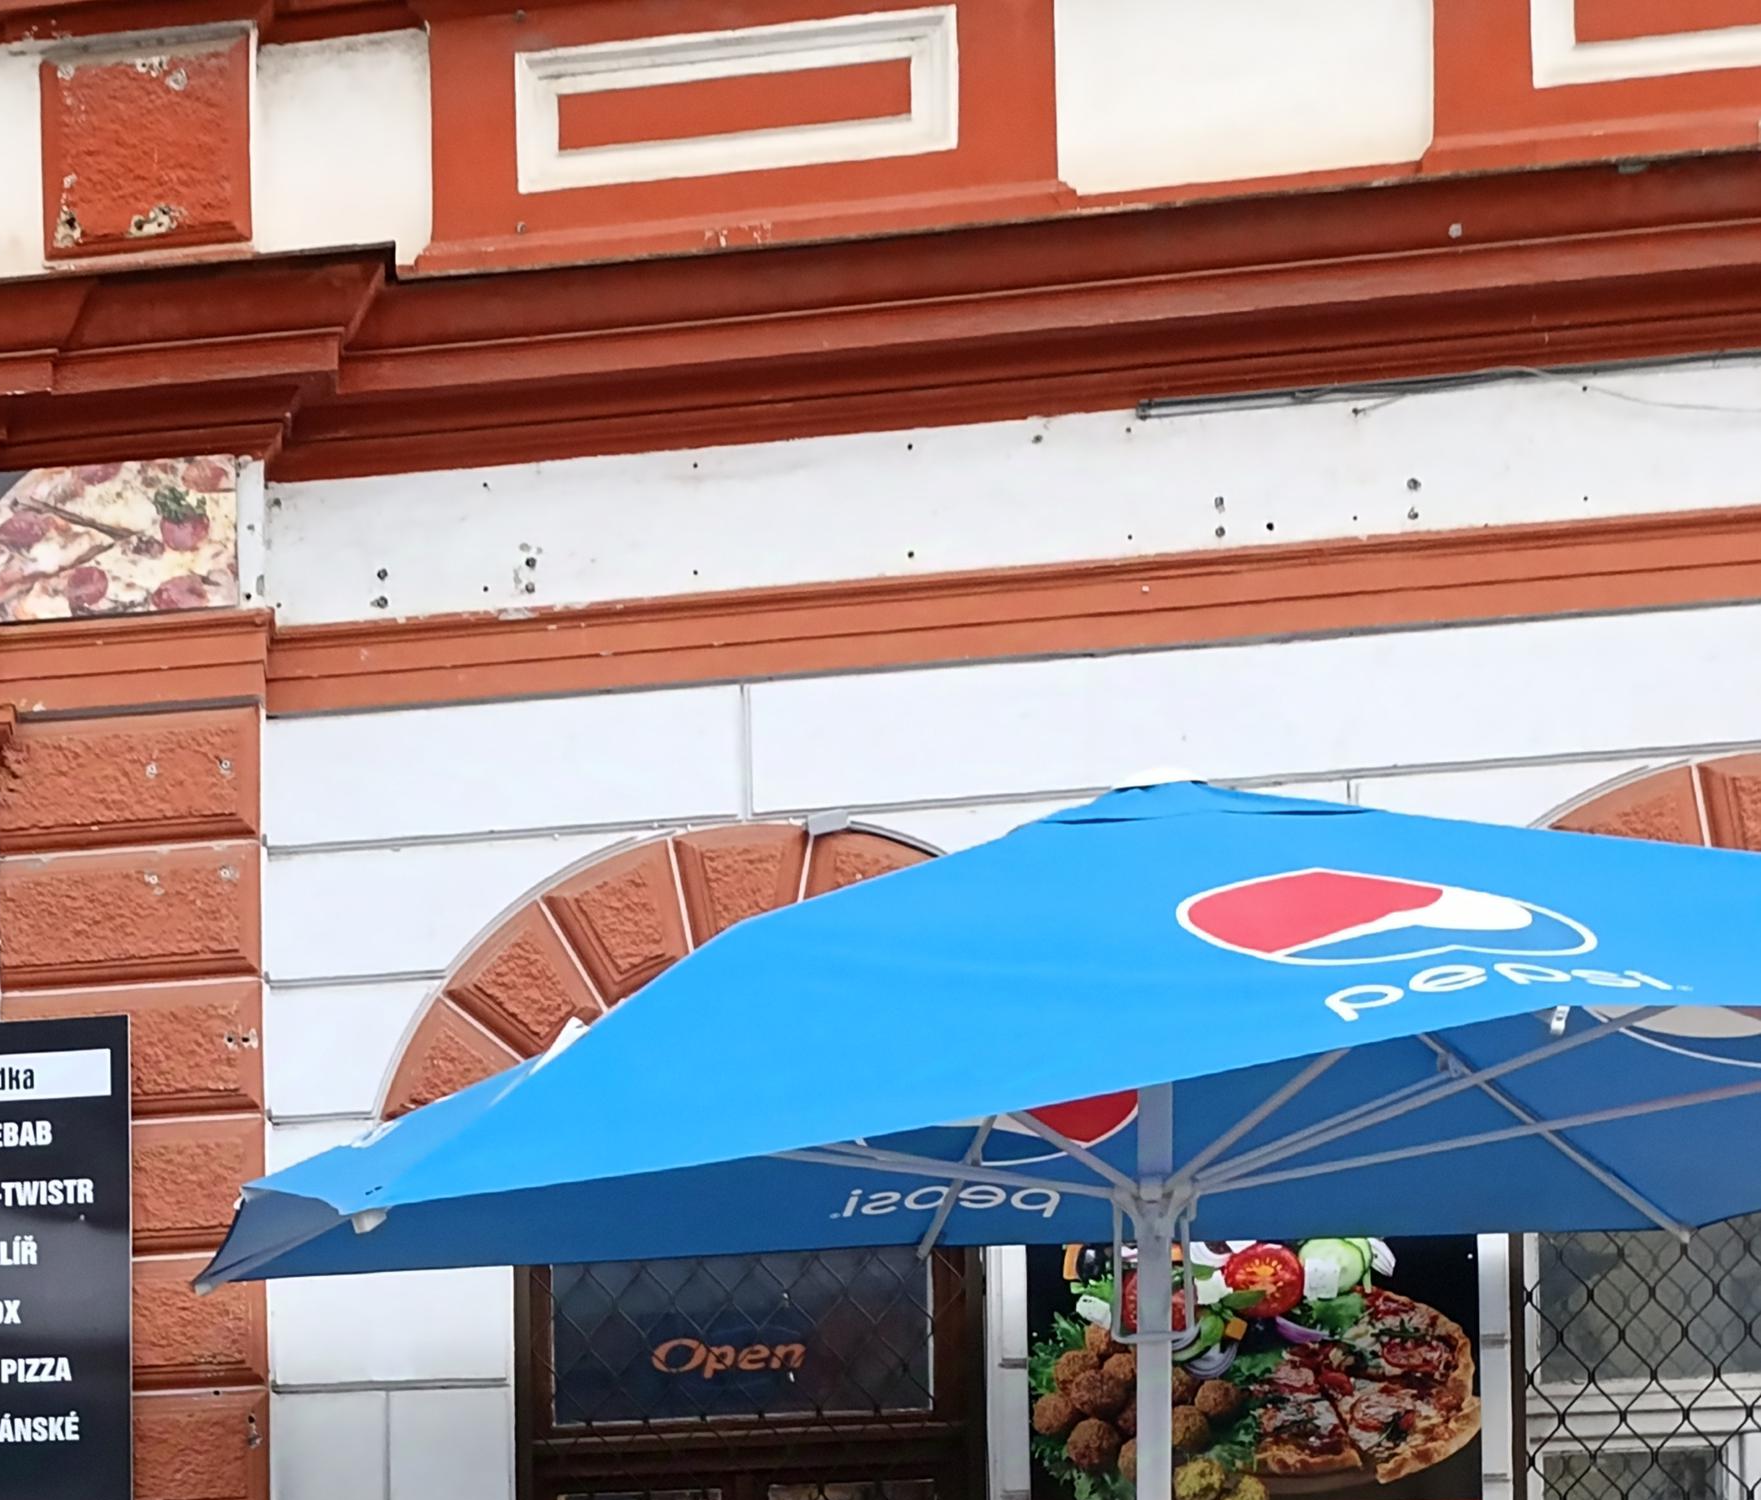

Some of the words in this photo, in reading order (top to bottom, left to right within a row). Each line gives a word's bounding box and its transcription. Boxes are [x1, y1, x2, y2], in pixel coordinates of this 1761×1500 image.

[1324, 964, 1674, 1021] pepsi
[1, 1358, 72, 1384] PIZZA
[651, 1338, 807, 1379] Open
